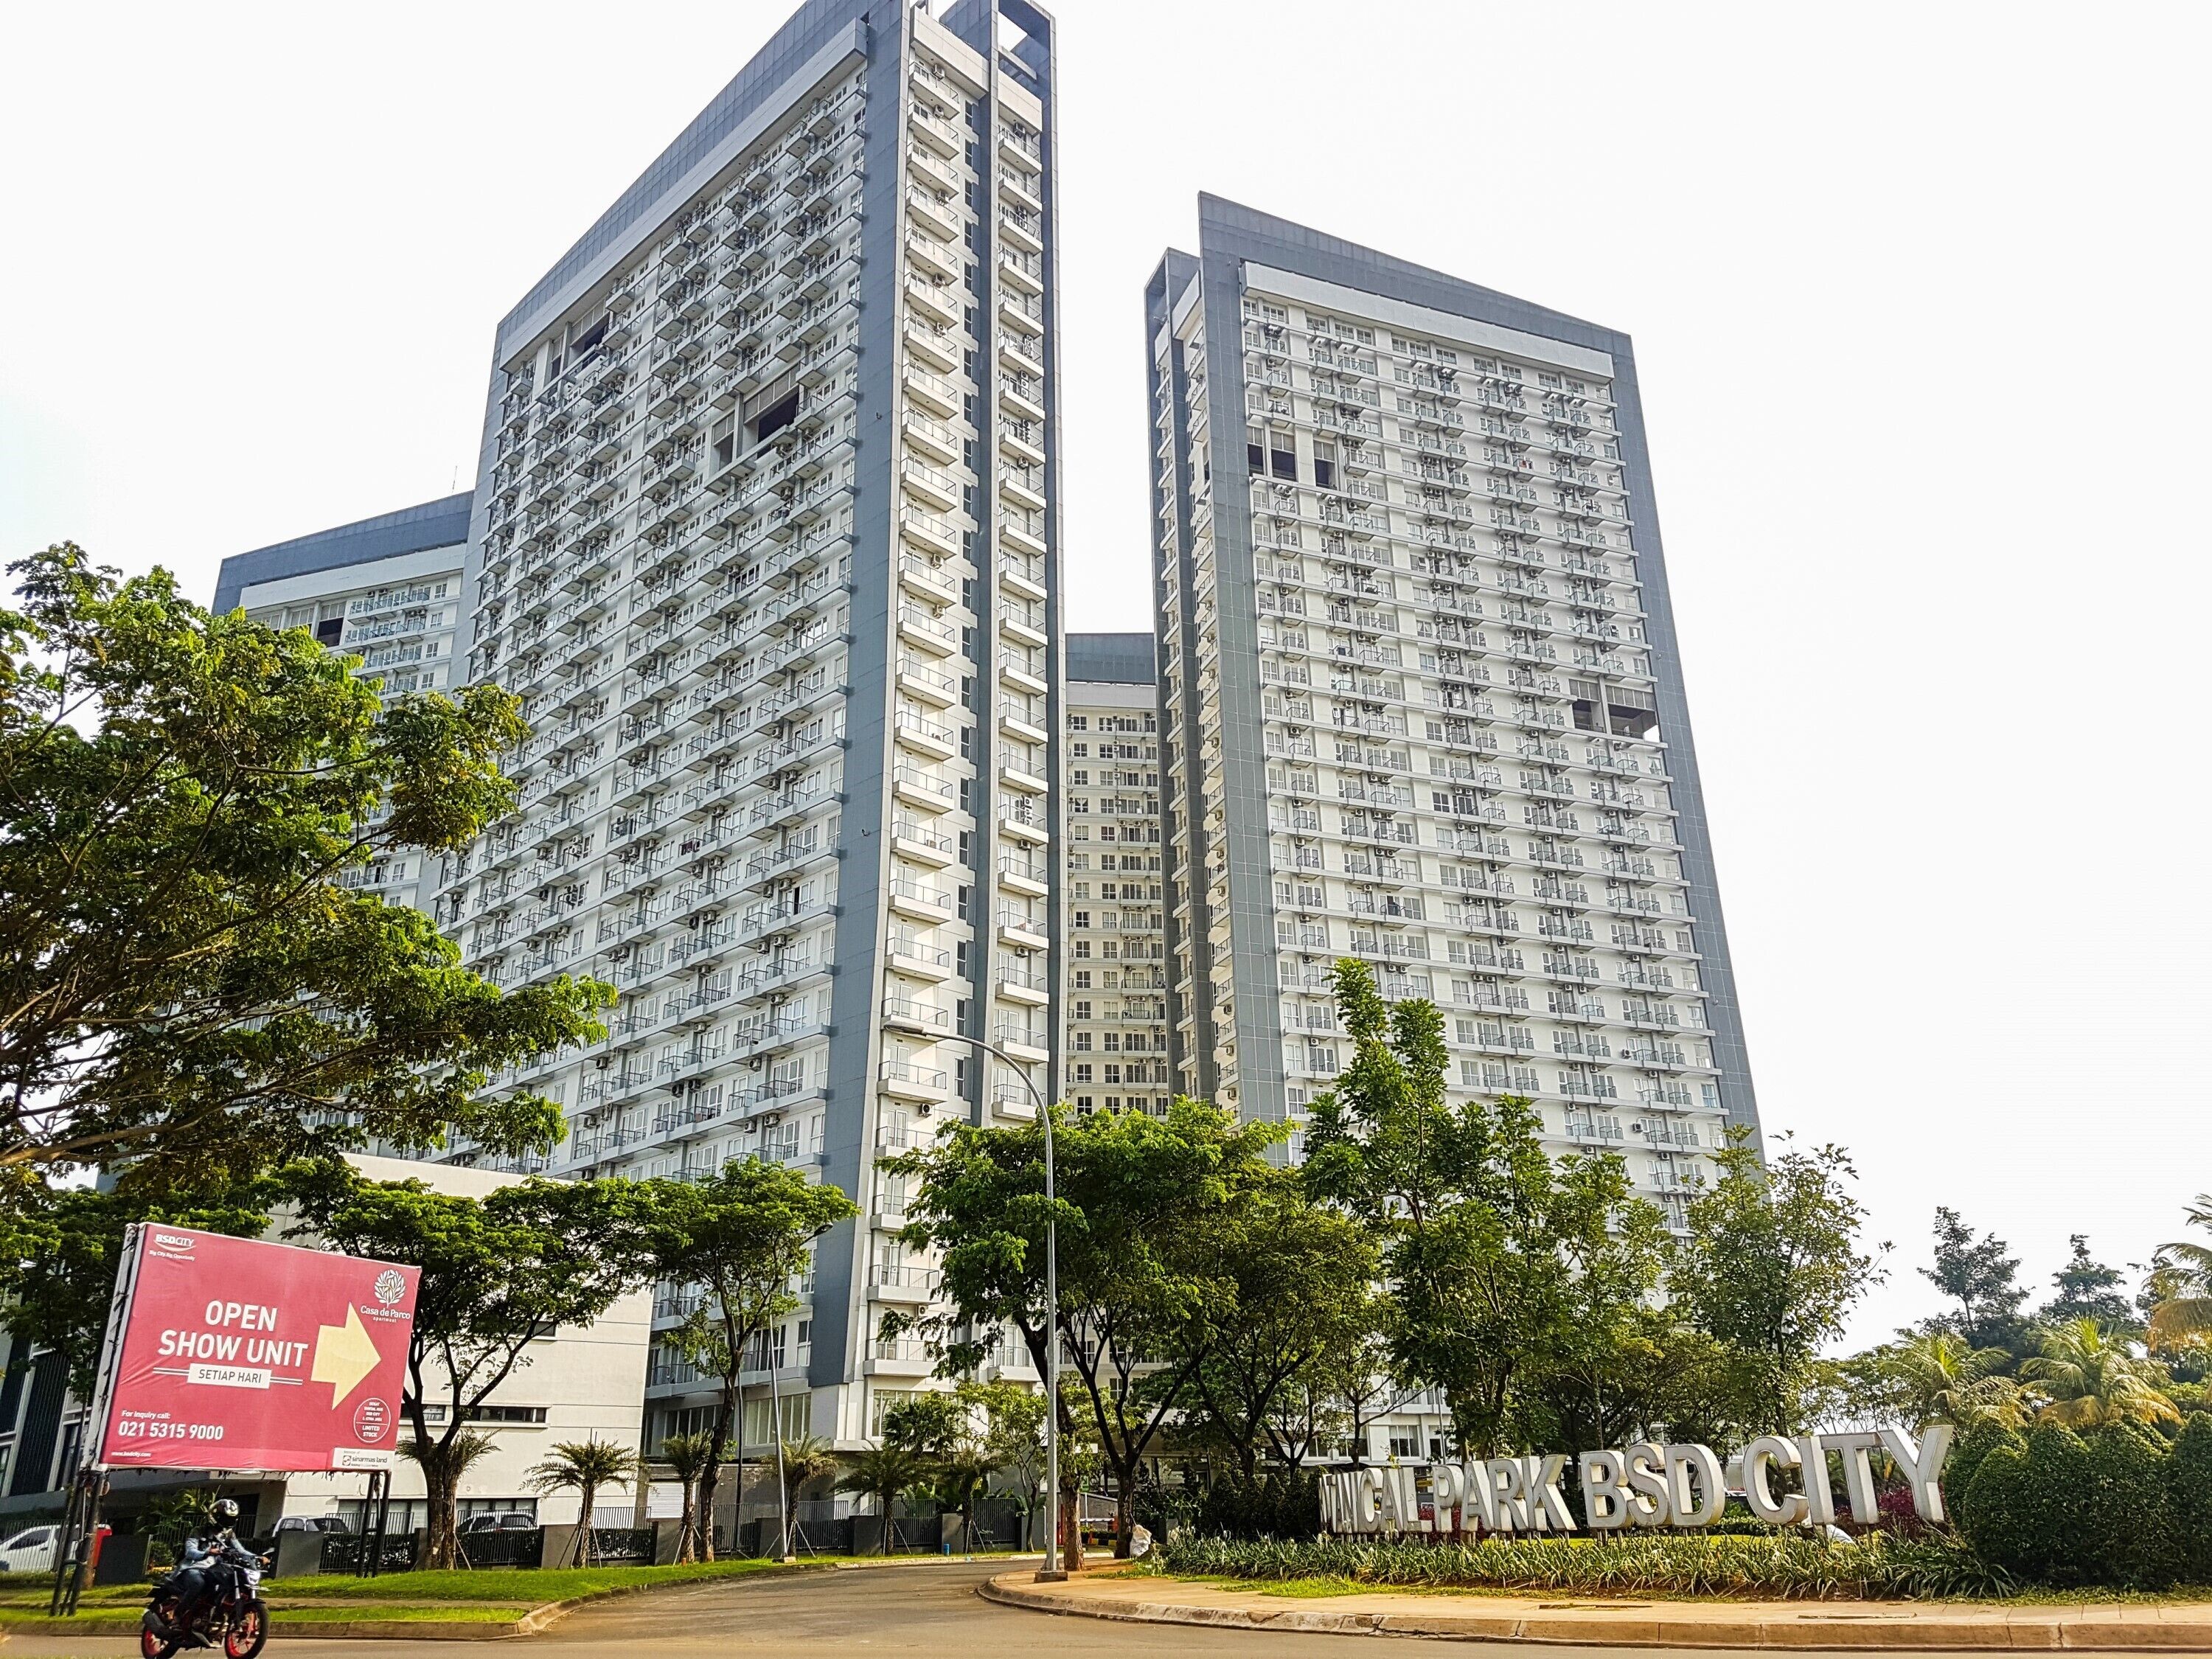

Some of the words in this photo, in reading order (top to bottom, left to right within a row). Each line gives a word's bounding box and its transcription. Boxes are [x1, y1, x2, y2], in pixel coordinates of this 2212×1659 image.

[205, 1300, 277, 1332] OPEN
[361, 1305, 378, 1315] Casa
[380, 1308, 389, 1317] de
[390, 1309, 411, 1319] Parco
[158, 1329, 243, 1361] SHOW
[246, 1338, 308, 1367] UNIT
[198, 1369, 235, 1381] SETIAP
[237, 1372, 262, 1383] HARI
[118, 1420, 146, 1437] 021
[149, 1422, 187, 1439] 5315
[189, 1424, 224, 1440] 9000
[1433, 1455, 1578, 1532] PARK
[1579, 1443, 1726, 1528] BSD
[1742, 1425, 1955, 1526] CITY
